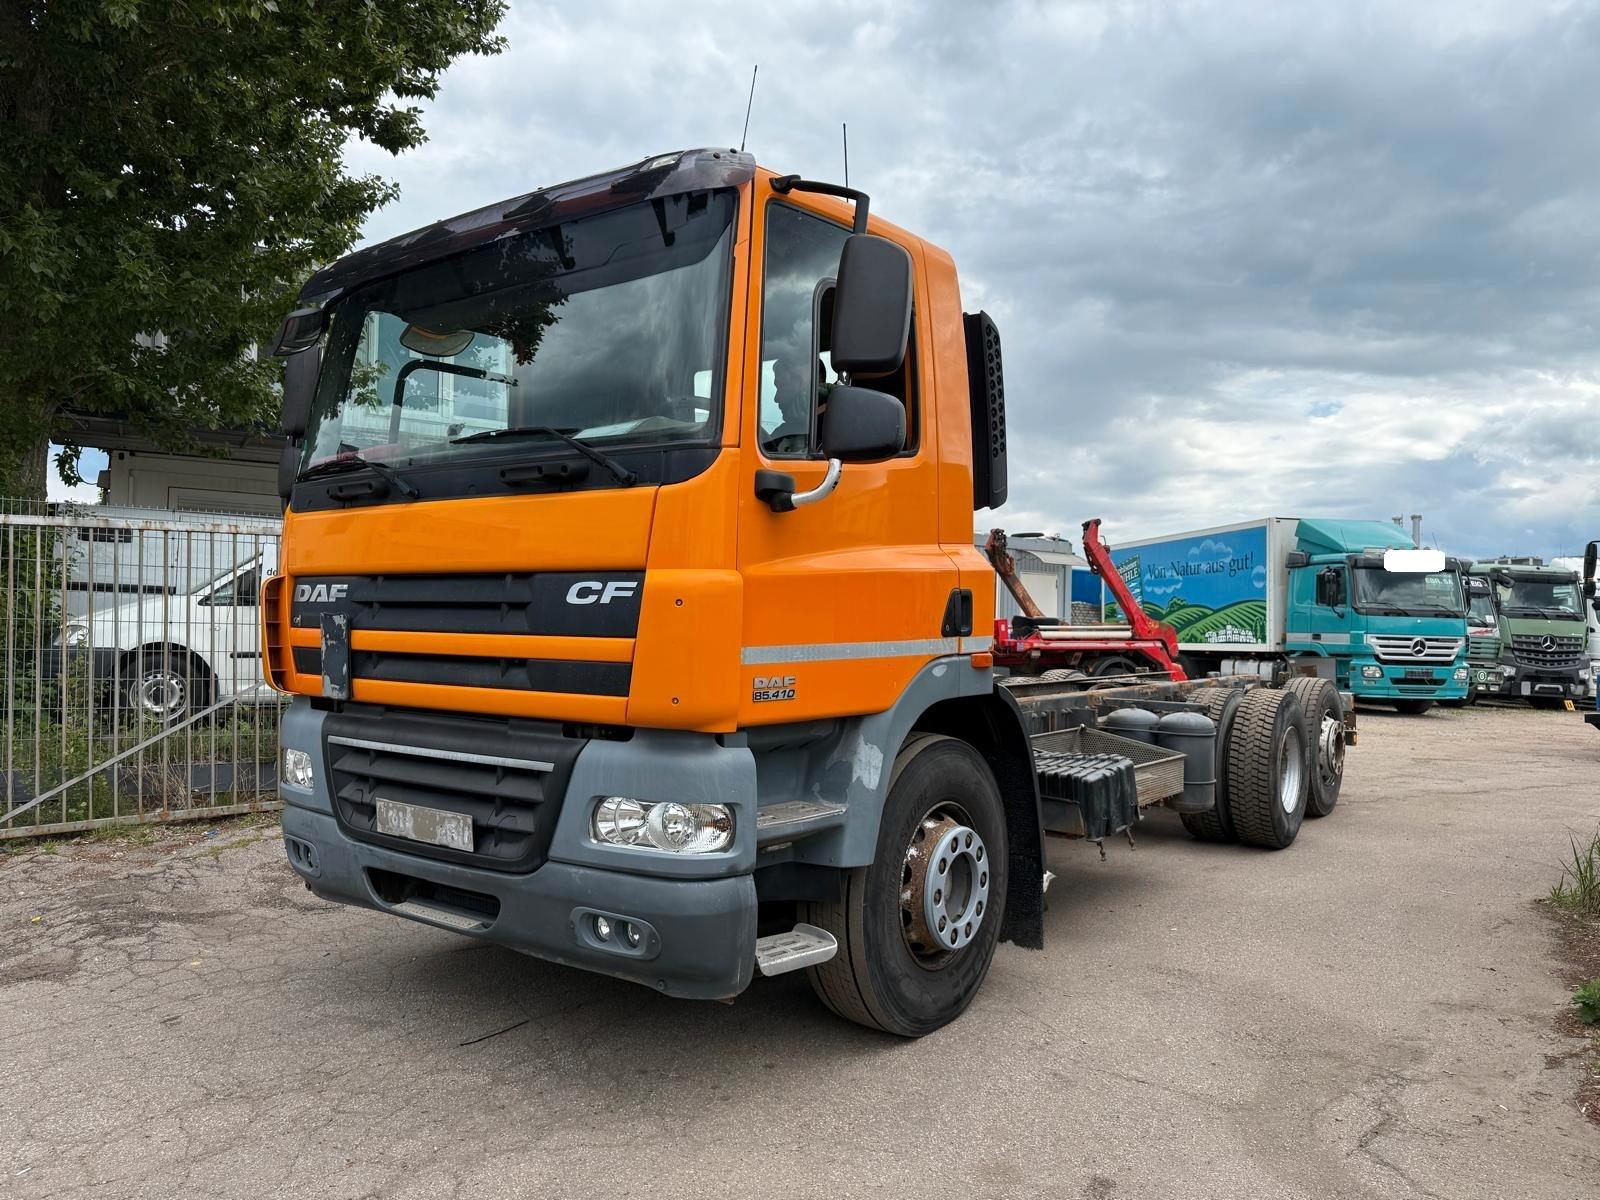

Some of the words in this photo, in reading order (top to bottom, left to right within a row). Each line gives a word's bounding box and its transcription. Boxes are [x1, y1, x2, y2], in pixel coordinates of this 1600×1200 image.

[1147, 563, 1167, 579] Von
[1171, 560, 1201, 577] Natur
[1205, 560, 1224, 575] aus
[1229, 551, 1254, 578] gut!
[294, 584, 349, 603] DAF
[565, 581, 638, 605] CF
[753, 675, 796, 690] DAF
[753, 689, 796, 701] 85.410
